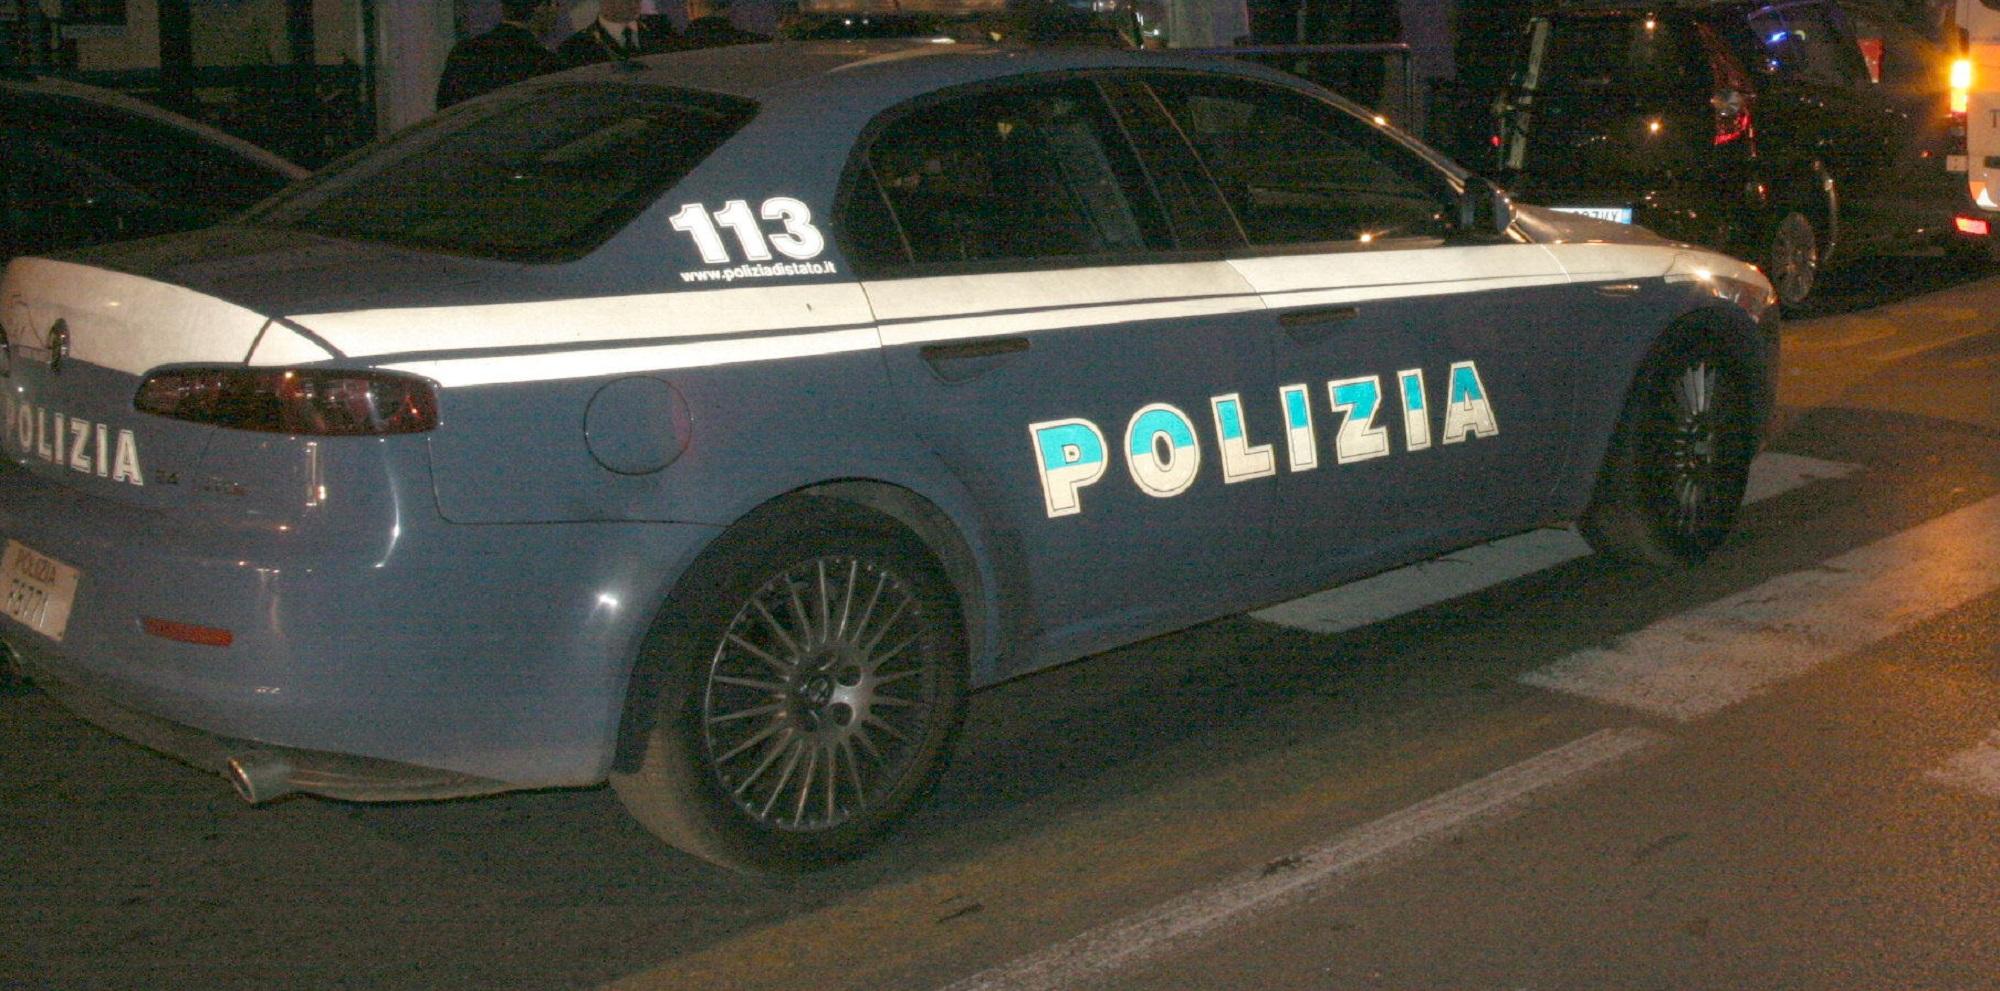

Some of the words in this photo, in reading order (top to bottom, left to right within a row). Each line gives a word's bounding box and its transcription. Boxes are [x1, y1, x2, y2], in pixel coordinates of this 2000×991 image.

[669, 197, 825, 264] 113
[680, 261, 837, 282] www.poliziadistato.it
[5, 400, 143, 486] POLIZIA
[1029, 361, 1499, 518] POLIZIA
